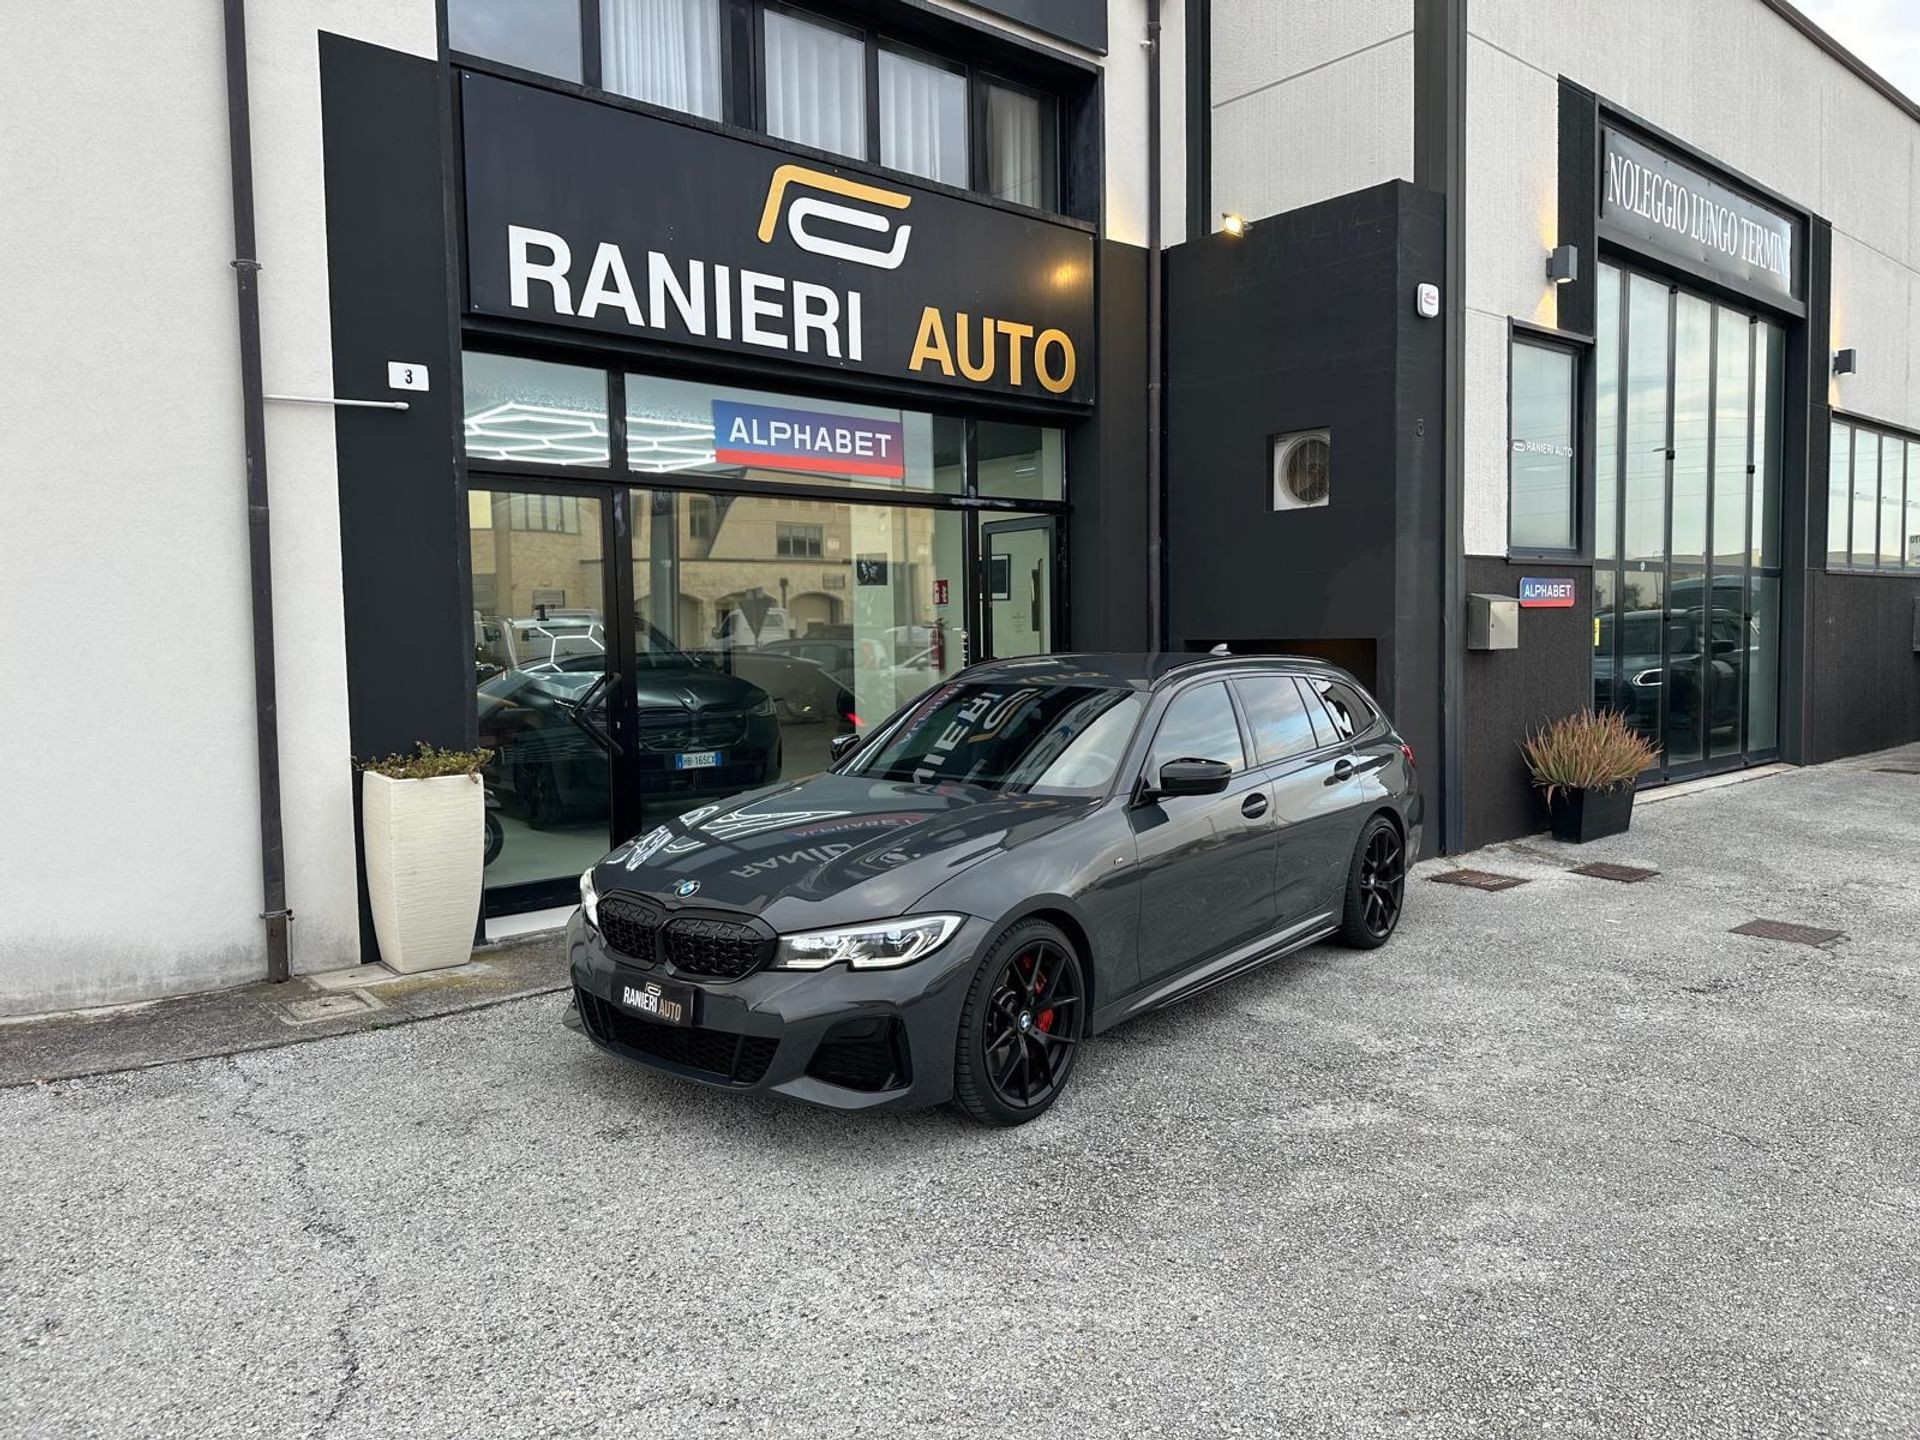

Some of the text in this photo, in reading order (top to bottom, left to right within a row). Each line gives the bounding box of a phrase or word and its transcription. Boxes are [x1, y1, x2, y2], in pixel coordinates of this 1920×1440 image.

[1608, 152, 1689, 235] NOLEGGIO
[1691, 193, 1738, 257] LUNGO
[508, 224, 1076, 393] RANIERI AUTO
[404, 369, 413, 384] 3
[729, 416, 891, 458] ALPHABET
[1526, 441, 1573, 458] RANIERI AUTO
[1524, 584, 1572, 598] ALPHABET
[623, 986, 682, 1021] RANIERI AUTO
